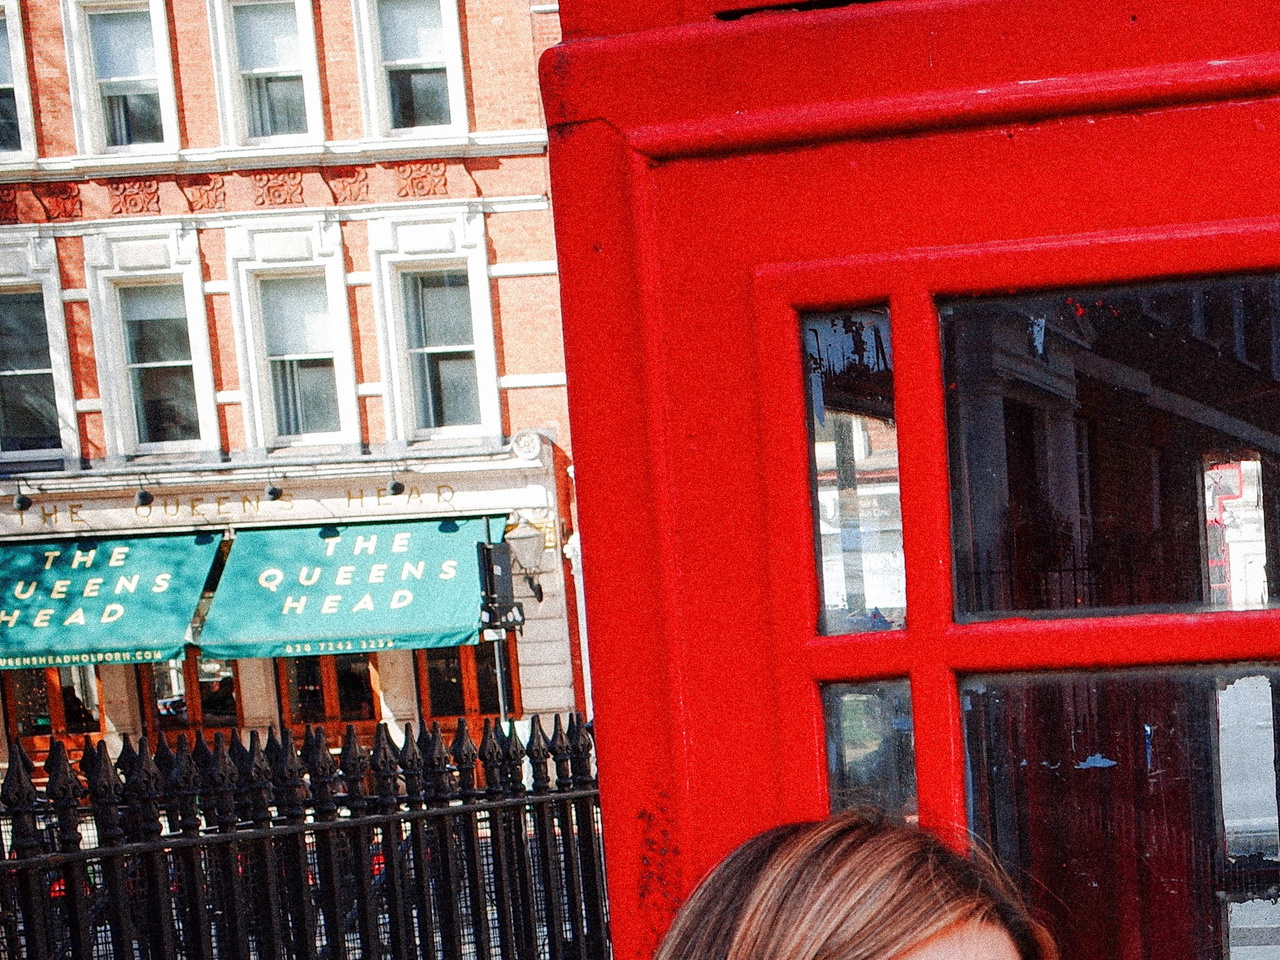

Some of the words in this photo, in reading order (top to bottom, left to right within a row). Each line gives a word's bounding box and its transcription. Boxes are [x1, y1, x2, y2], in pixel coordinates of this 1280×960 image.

[18, 503, 85, 526] THE
[134, 492, 295, 519] QUEENS
[346, 484, 456, 508] HEAD
[324, 532, 412, 556] THE
[44, 546, 130, 570] THE
[257, 560, 459, 592] QUEENS
[0, 603, 125, 627] HEAD
[282, 589, 414, 616] HEAD
